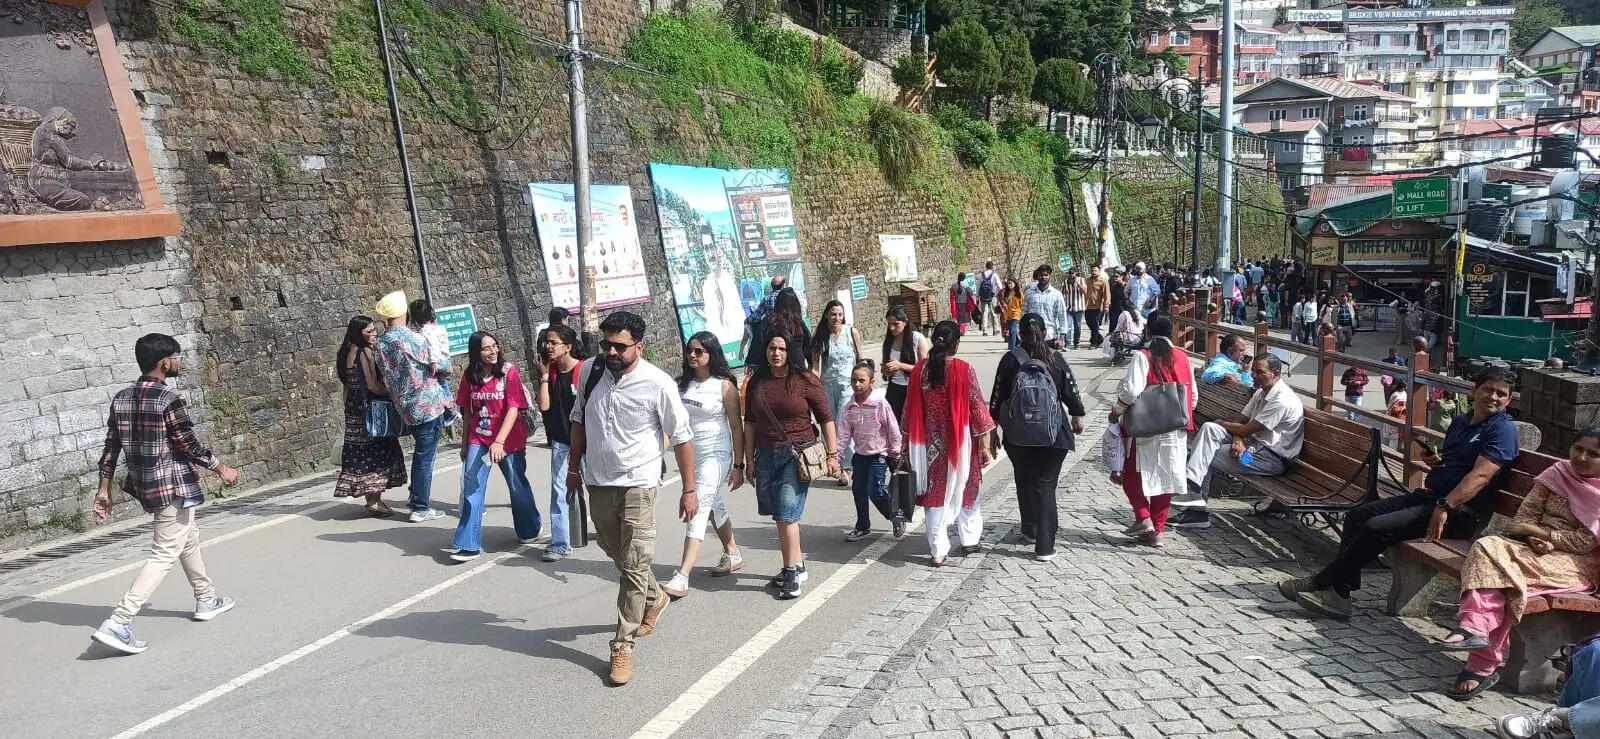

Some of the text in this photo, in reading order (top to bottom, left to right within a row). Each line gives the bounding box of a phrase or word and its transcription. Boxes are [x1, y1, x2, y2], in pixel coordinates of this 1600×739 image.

[1300, 11, 1331, 20] treebo
[1348, 11, 1373, 19] BRIDGE
[1391, 10, 1422, 18] REGENCY
[1459, 8, 1516, 16] MICROBREWERY
[1406, 190, 1445, 199] MALL ROAD
[1406, 203, 1425, 212] LIFT
[472, 391, 505, 400] EMENS
